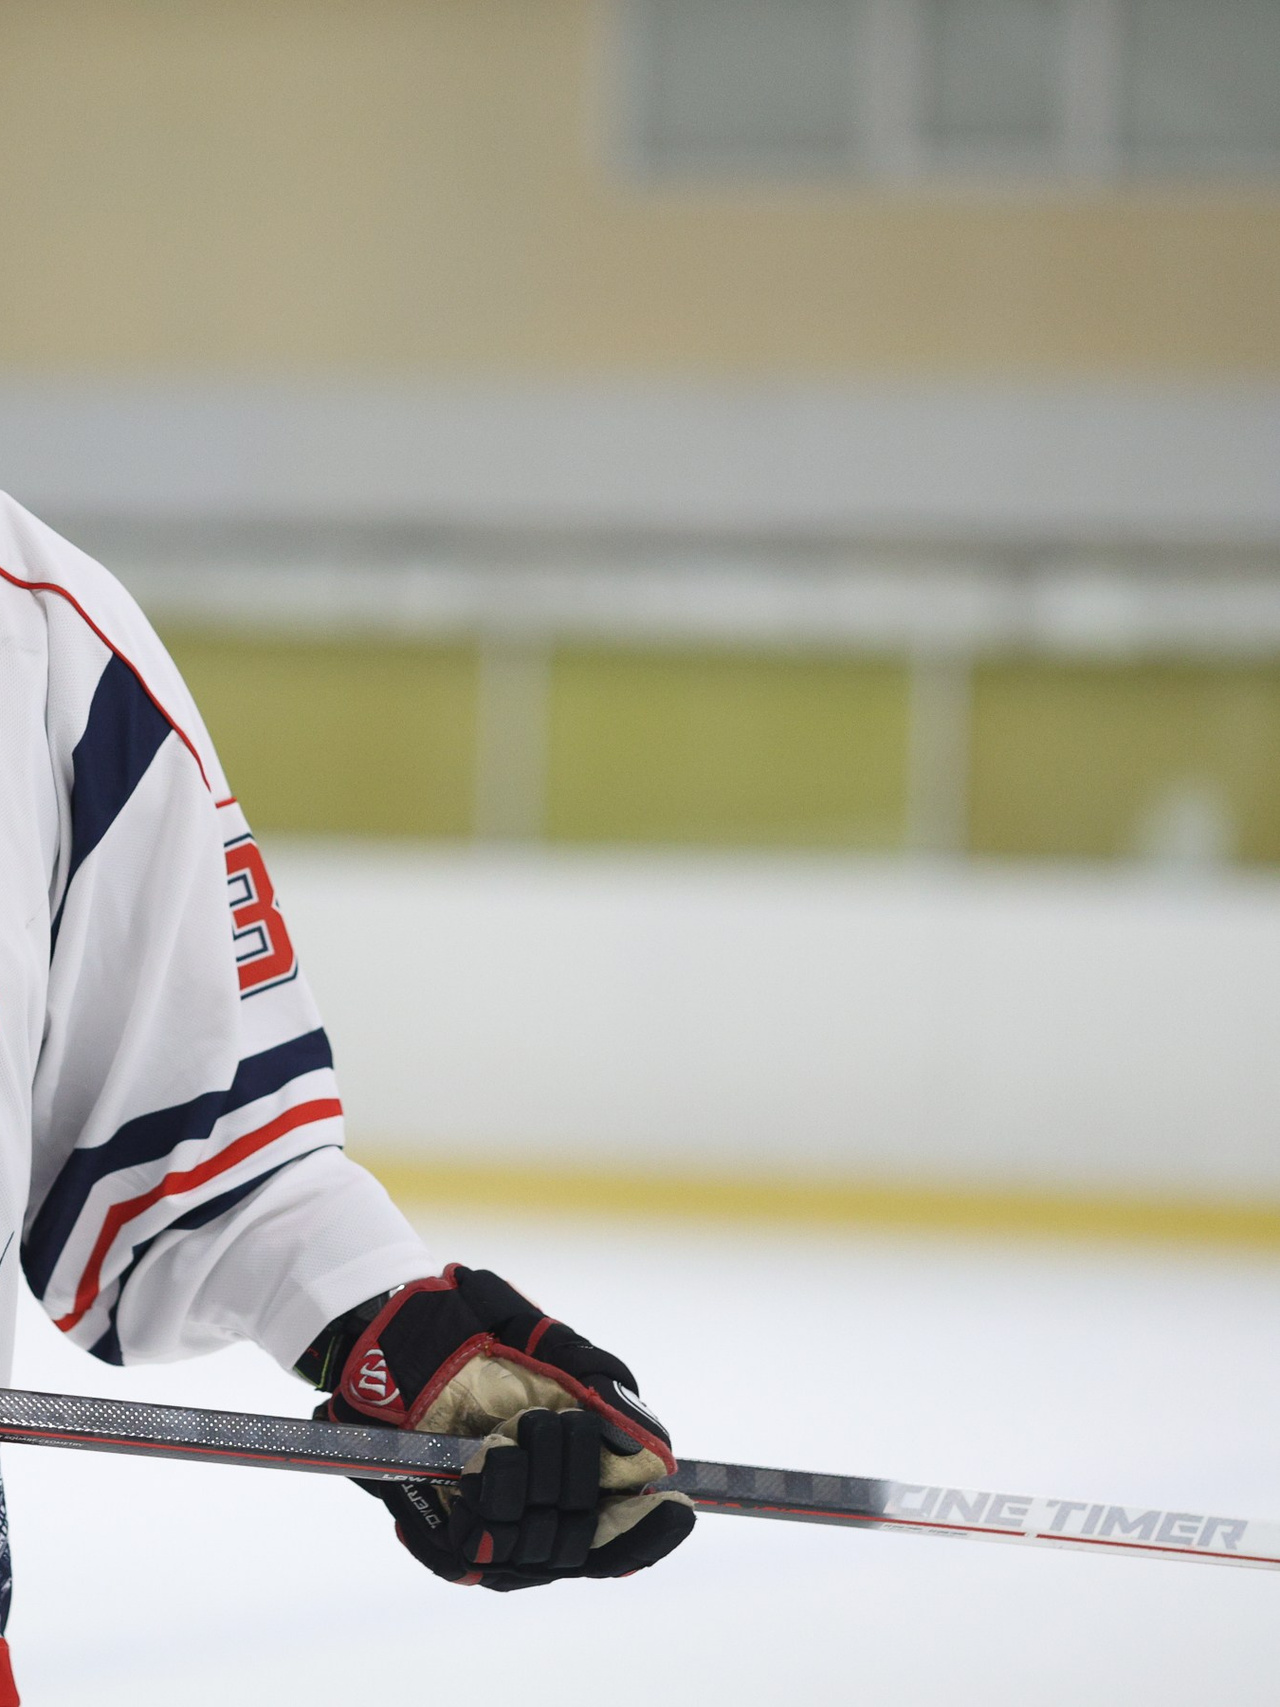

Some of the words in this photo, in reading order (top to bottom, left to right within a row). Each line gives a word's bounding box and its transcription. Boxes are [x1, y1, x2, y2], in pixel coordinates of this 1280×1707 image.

[223, 832, 299, 1001] 3
[381, 1473, 427, 1483] LOW
[1045, 1499, 1250, 1551] TIMER
